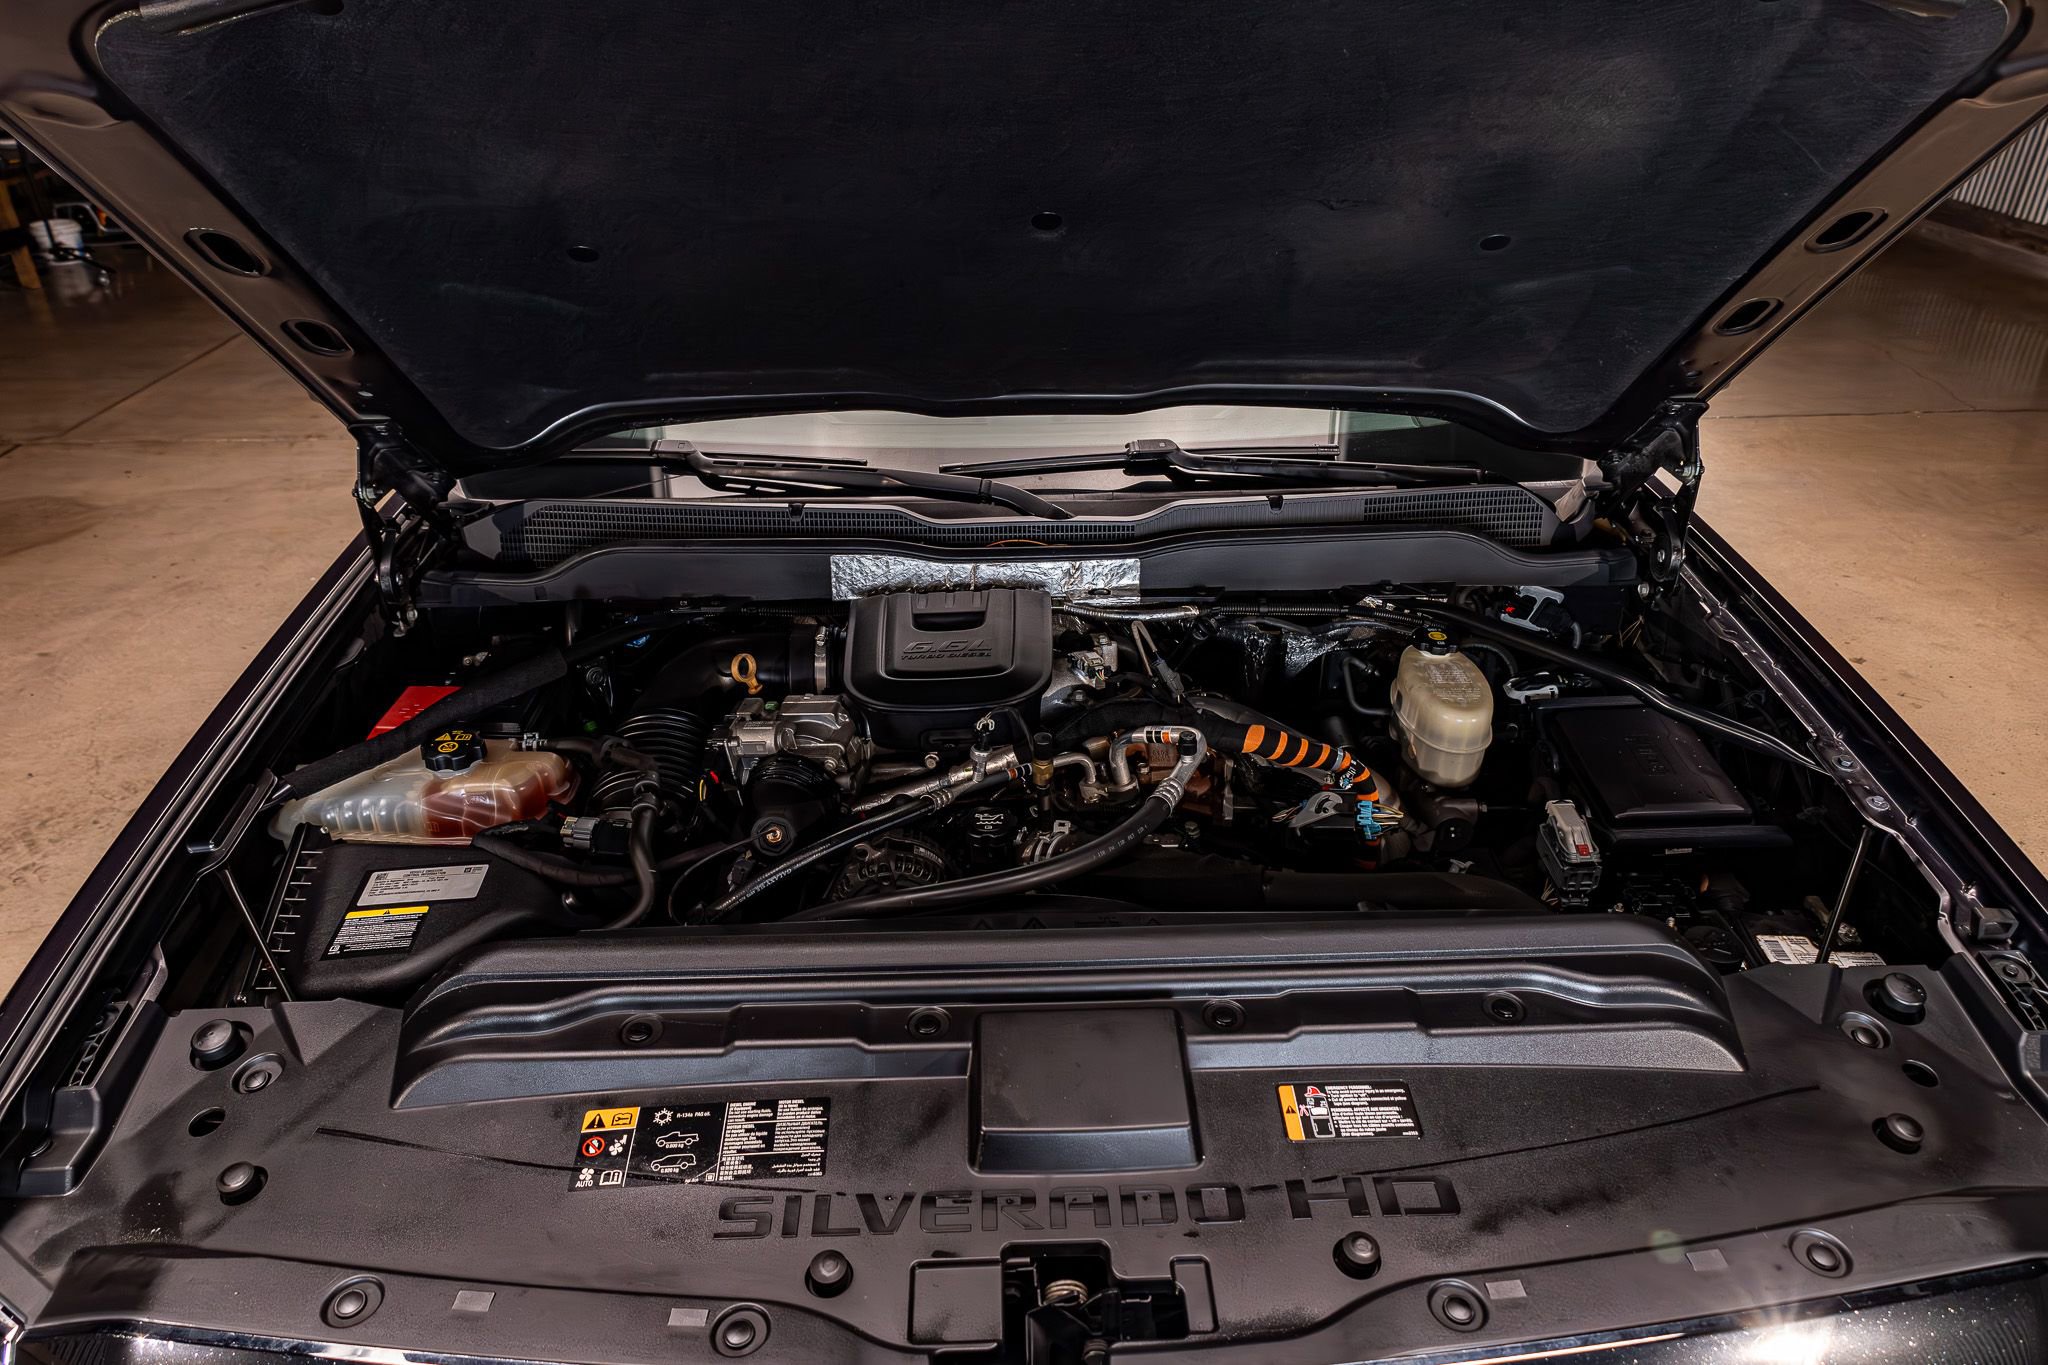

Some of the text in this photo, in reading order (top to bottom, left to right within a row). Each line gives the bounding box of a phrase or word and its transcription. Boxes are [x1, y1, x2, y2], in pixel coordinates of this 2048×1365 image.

[904, 640, 992, 654] 6.6L
[713, 1176, 1463, 1239] SILVERADO HD
